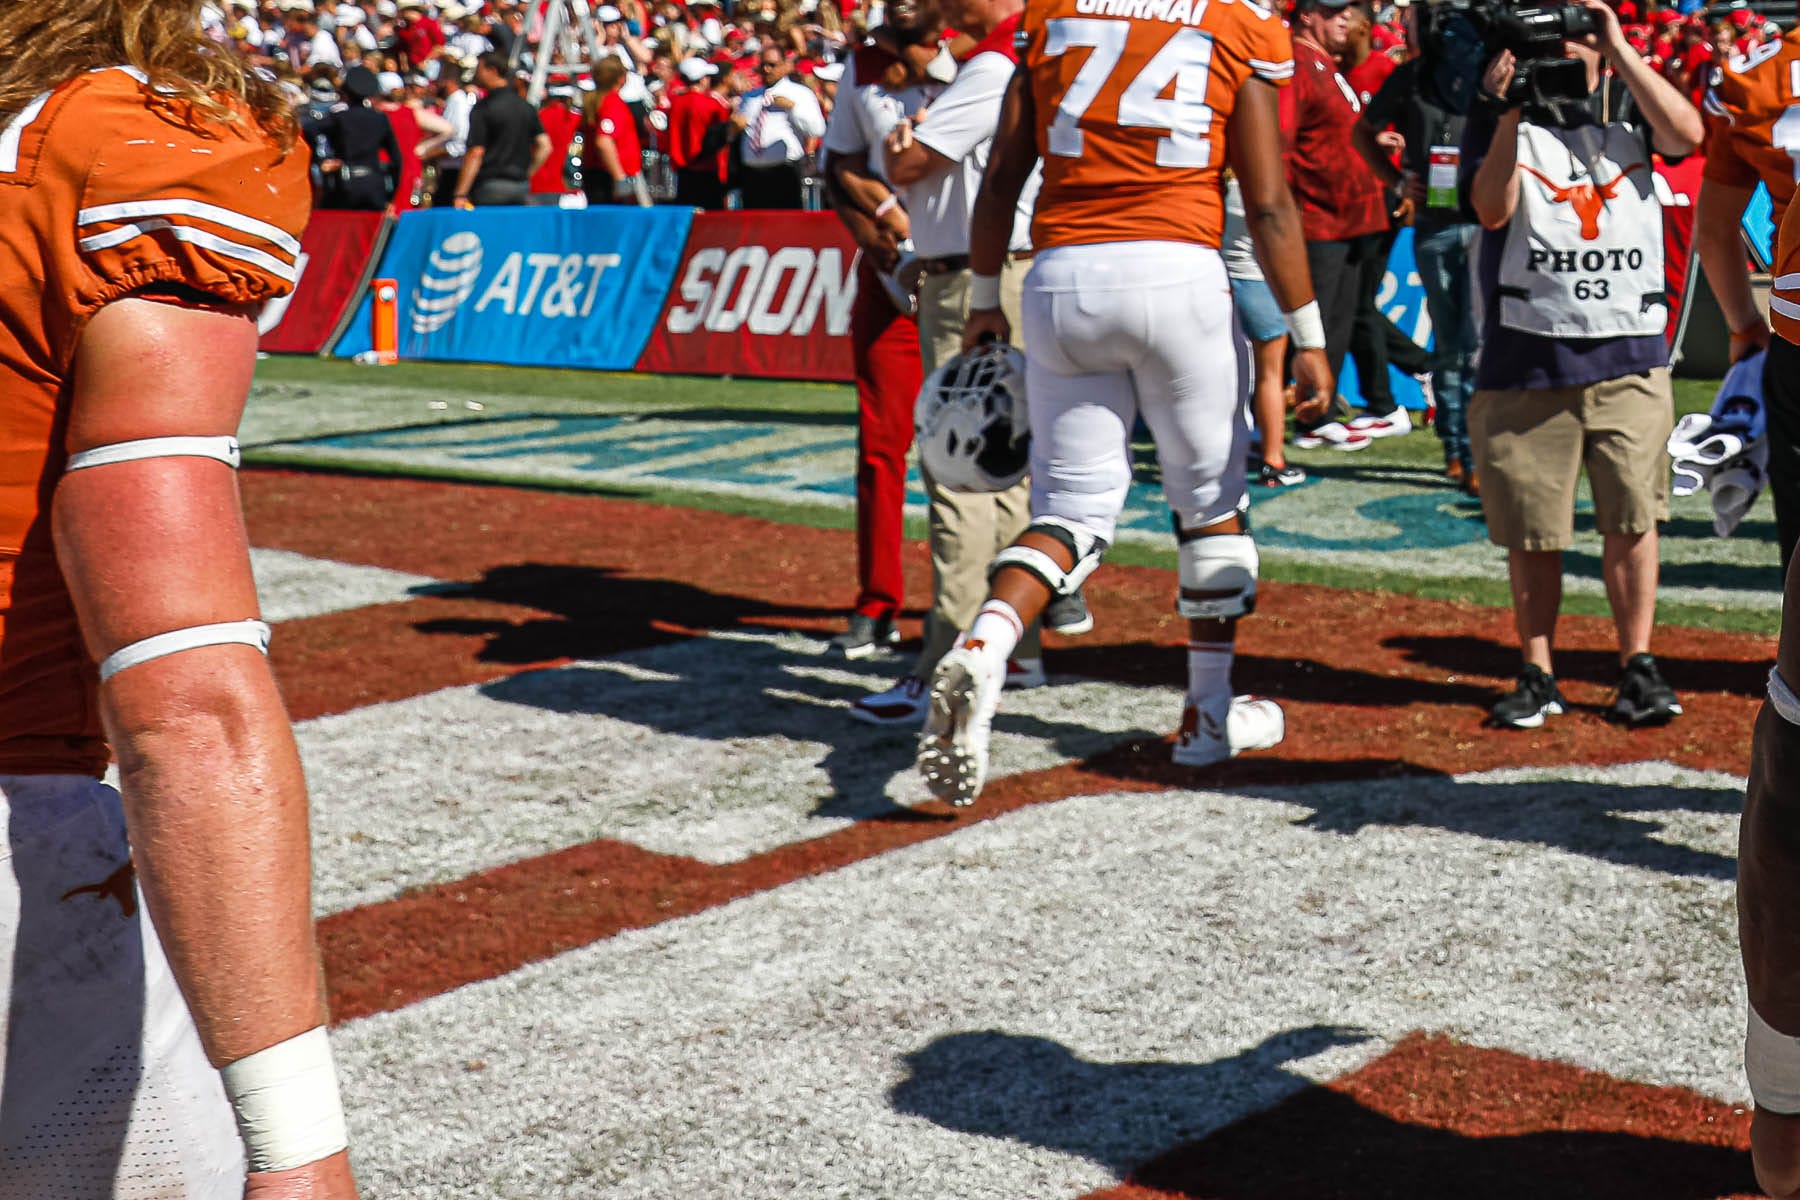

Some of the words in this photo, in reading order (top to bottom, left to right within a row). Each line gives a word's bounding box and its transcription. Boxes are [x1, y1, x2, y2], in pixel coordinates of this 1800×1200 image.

[1043, 17, 1213, 169] 74
[1526, 248, 1643, 274] PHOTO
[476, 251, 621, 319] AT&T
[1573, 279, 1610, 301] 63
